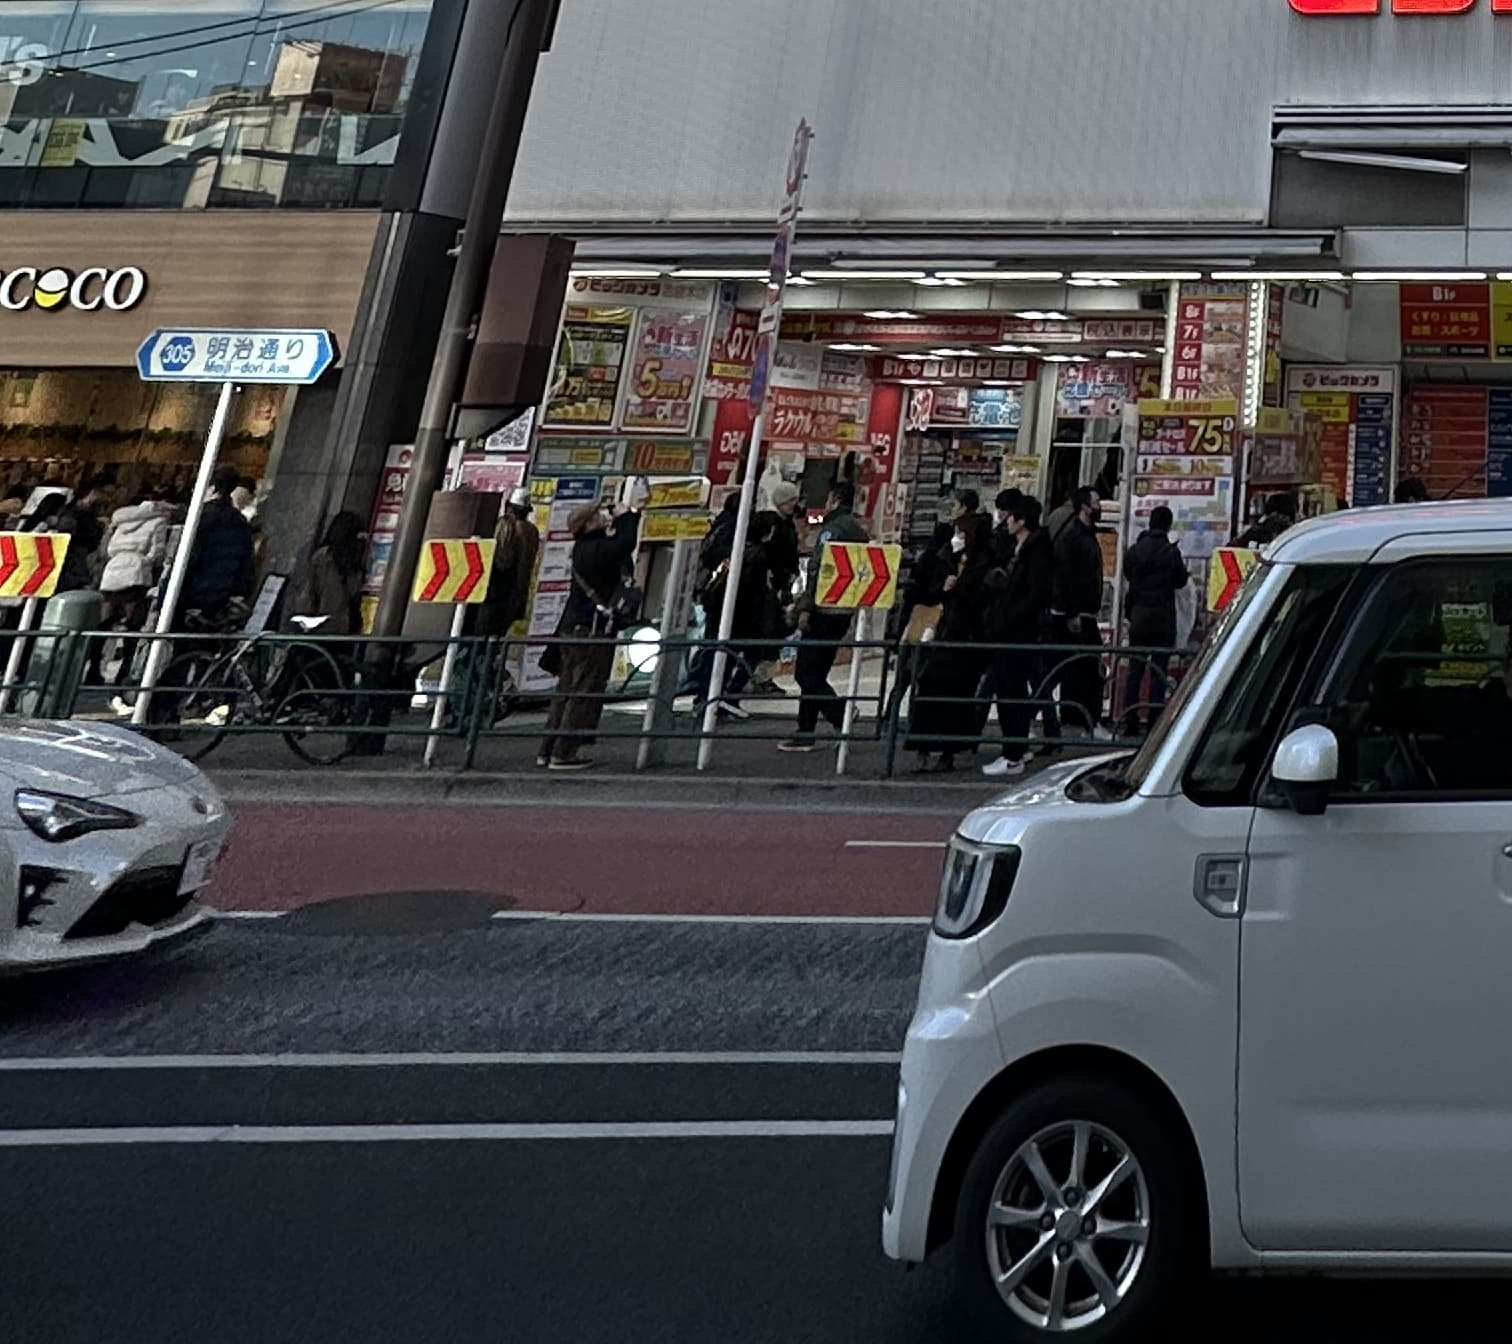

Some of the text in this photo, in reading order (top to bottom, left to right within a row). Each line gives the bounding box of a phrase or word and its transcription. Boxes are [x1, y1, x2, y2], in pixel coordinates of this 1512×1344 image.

[162, 343, 194, 365] 305
[206, 335, 305, 361] 明治通り
